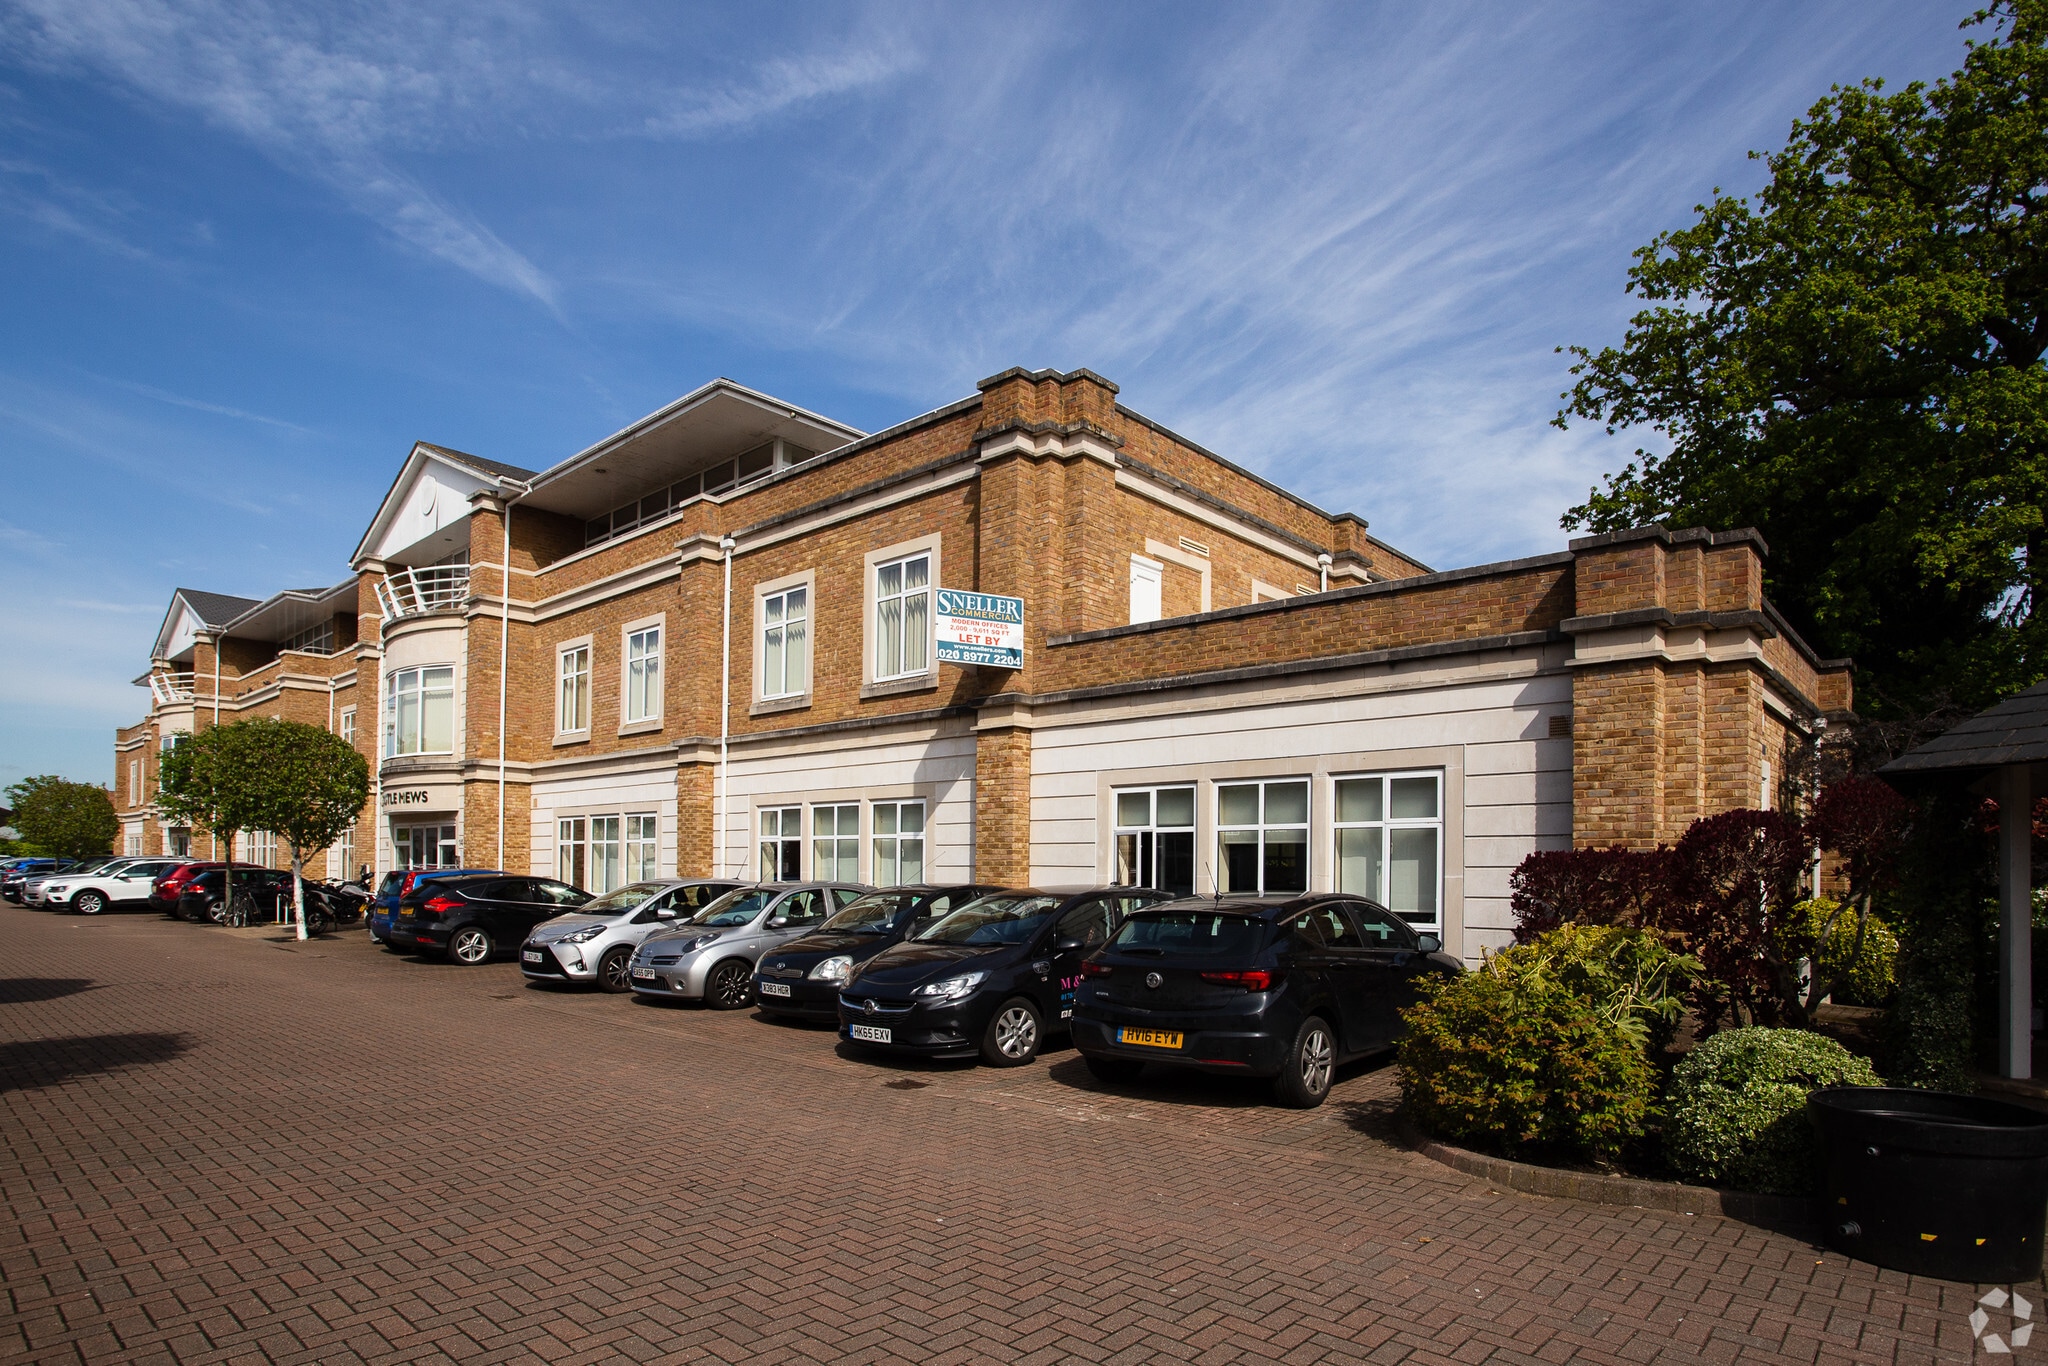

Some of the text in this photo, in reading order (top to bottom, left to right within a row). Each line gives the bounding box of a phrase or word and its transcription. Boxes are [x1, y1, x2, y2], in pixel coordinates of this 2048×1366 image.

[938, 591, 1020, 619] SNELLER
[951, 607, 1017, 622] COMMERCIAL
[951, 618, 1009, 630] MODERN OFFICES
[959, 633, 1000, 645] LET BY
[938, 648, 1020, 666] 020 8977 2204
[1060, 975, 1080, 990] M &
[853, 1025, 890, 1041] HK65 EXV
[1126, 1027, 1179, 1045] HV16 EYW
